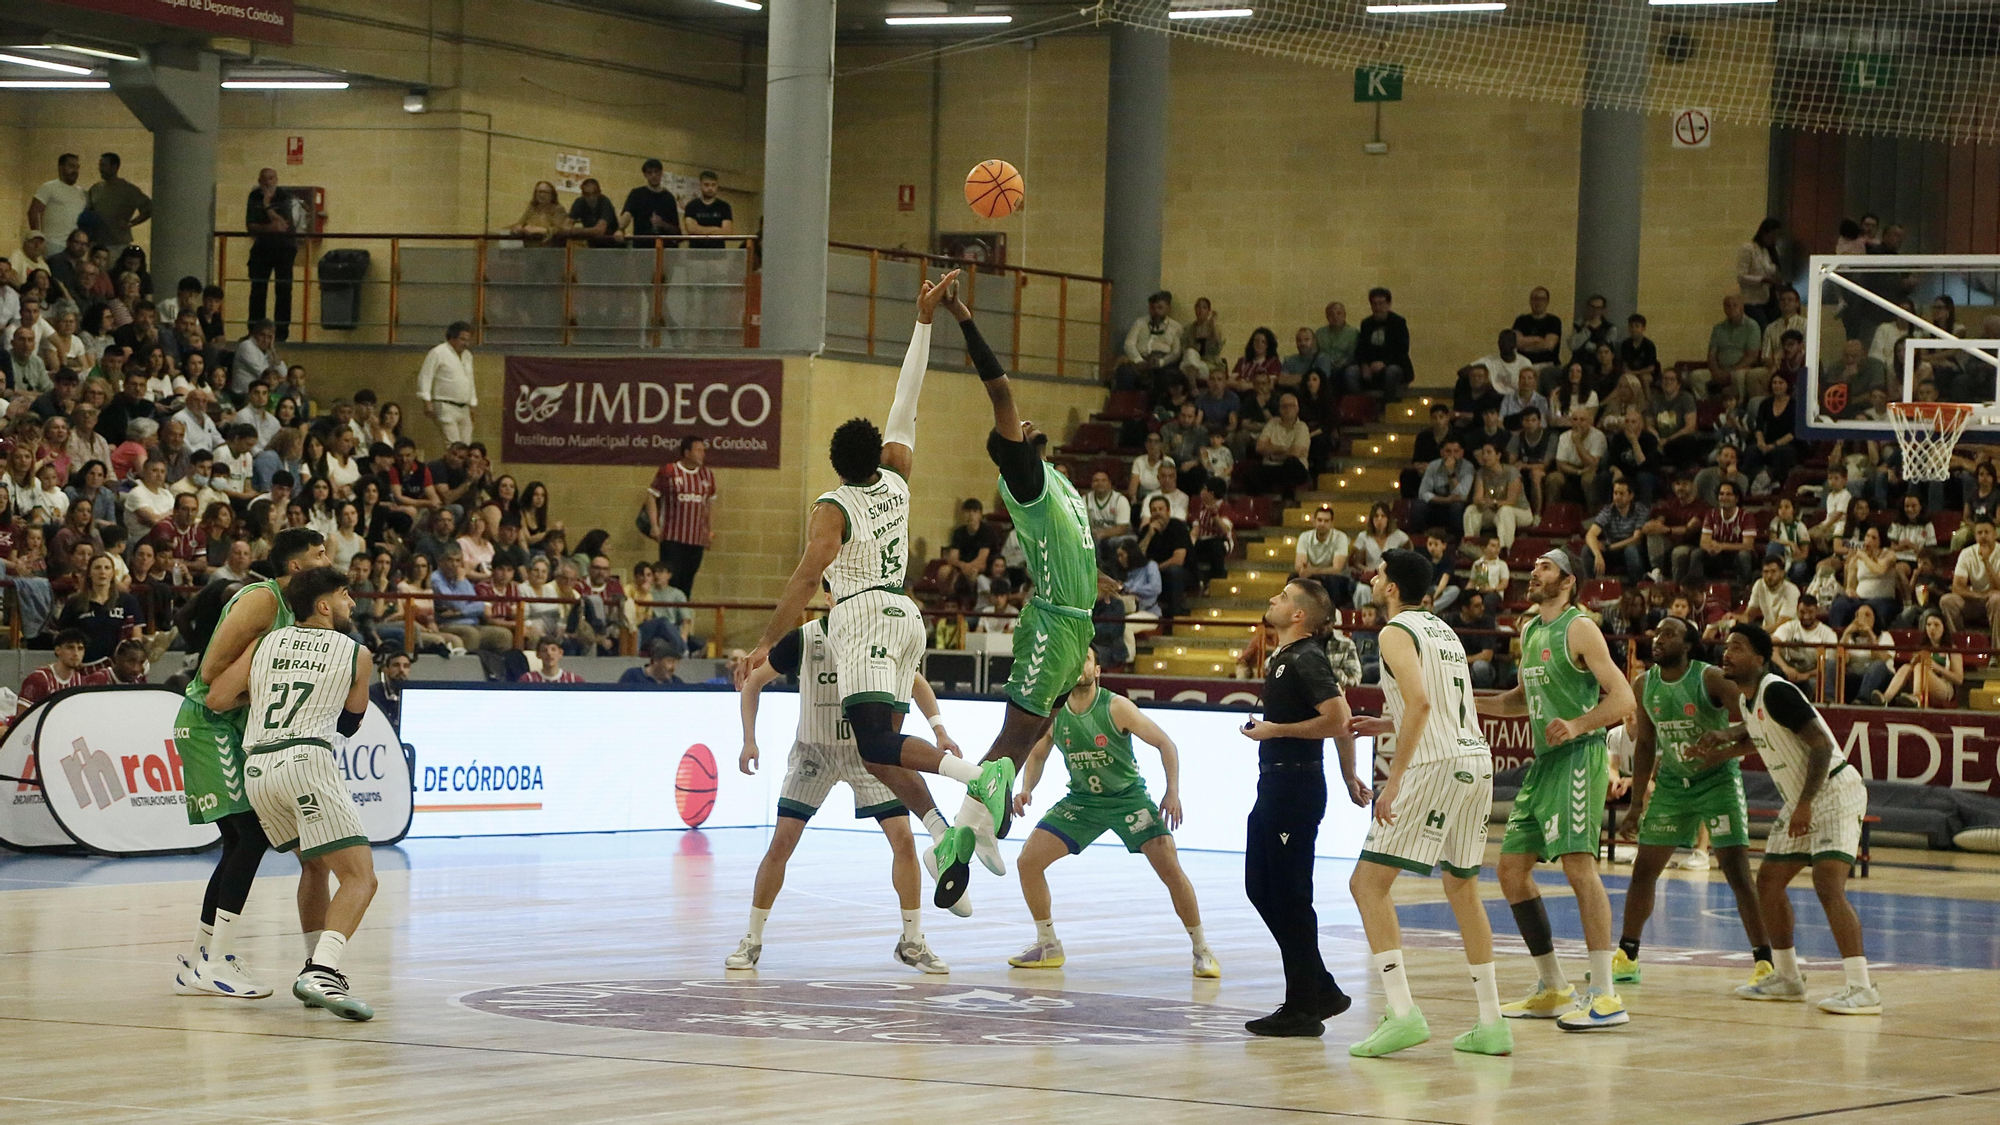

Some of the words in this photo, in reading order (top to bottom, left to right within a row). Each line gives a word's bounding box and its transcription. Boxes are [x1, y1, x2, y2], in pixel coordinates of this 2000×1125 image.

[204, 1, 246, 18] Deportes
[246, 7, 285, 26] Córdoba
[1368, 70, 1388, 97] K
[573, 382, 772, 427] IMDECO
[514, 432, 566, 447] Instituto
[567, 433, 630, 450] Municipal
[632, 434, 649, 448] de
[712, 436, 768, 451] Córdoba
[868, 493, 905, 520] SCHUTTE
[279, 637, 289, 650] F.
[292, 640, 330, 654] BELLO
[291, 659, 327, 673] RAHI
[263, 681, 316, 730] 27
[1453, 675, 1467, 729] 7
[1528, 694, 1544, 720] 42
[836, 719, 852, 741] 10
[1069, 750, 1108, 762] AMICS
[424, 766, 449, 792] DE
[452, 759, 544, 792] CÓRDOBA
[1088, 775, 1103, 794] 8
[129, 794, 178, 807] INSTALACIONES
[350, 790, 383, 807] eguros
